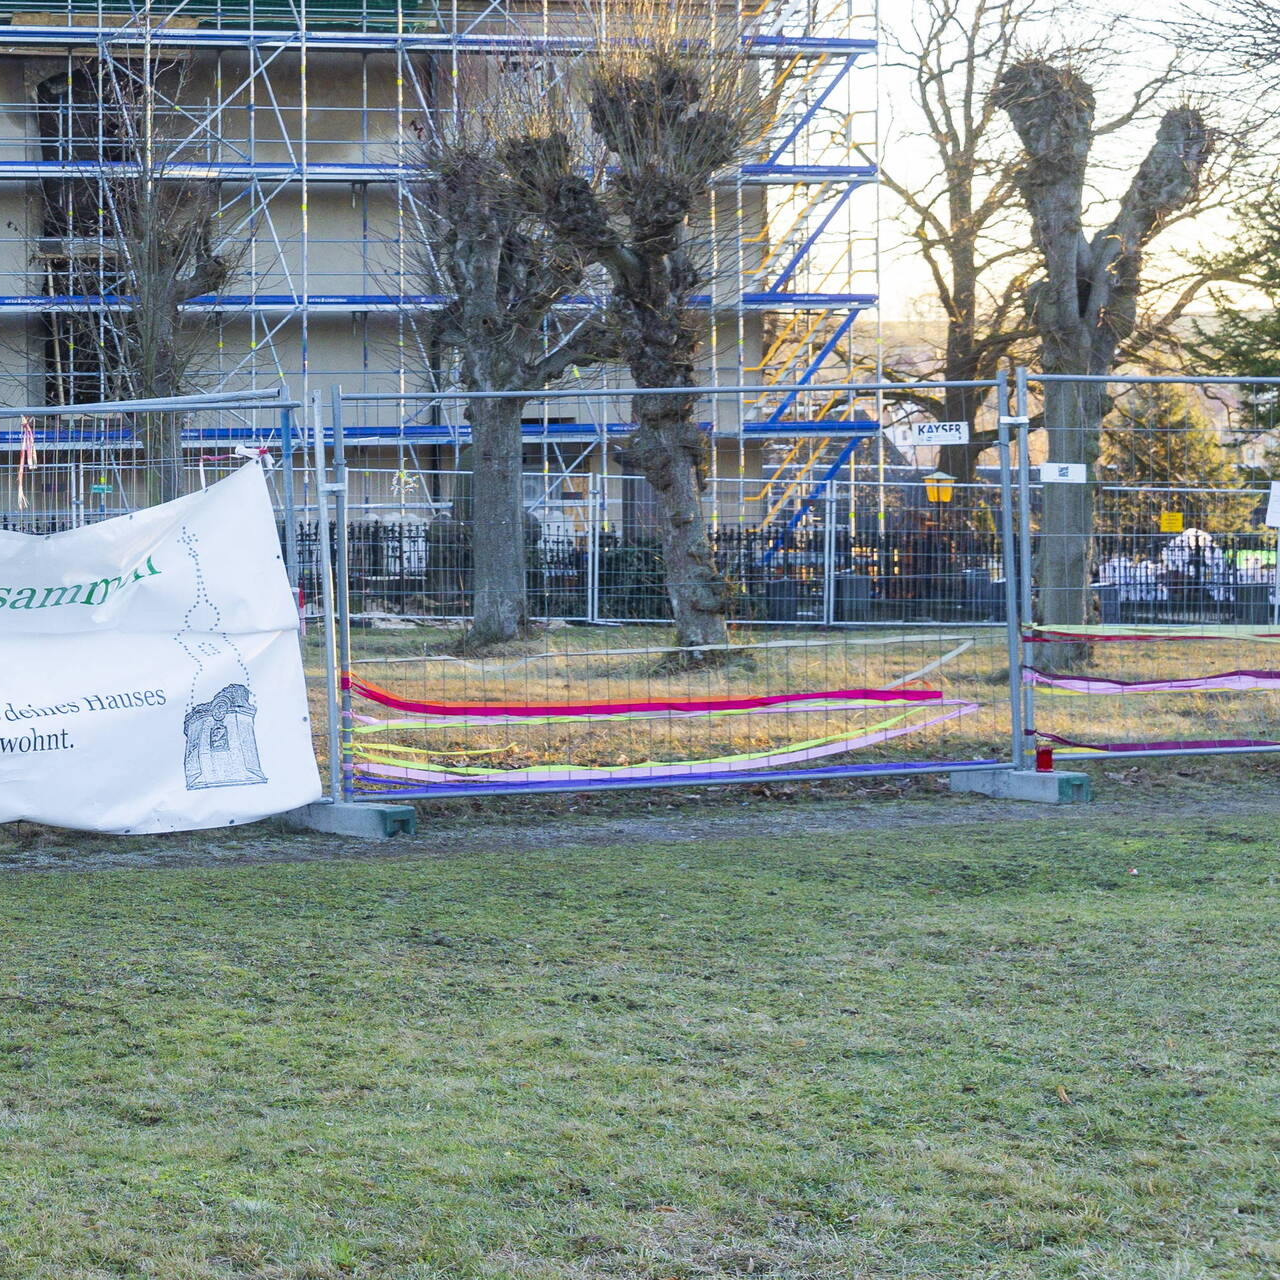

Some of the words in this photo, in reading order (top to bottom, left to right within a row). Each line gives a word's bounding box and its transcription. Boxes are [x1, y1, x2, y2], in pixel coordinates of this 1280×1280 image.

[4, 701, 80, 721] deines
[82, 688, 167, 712] Hauses
[0, 727, 75, 754] wohnt.
